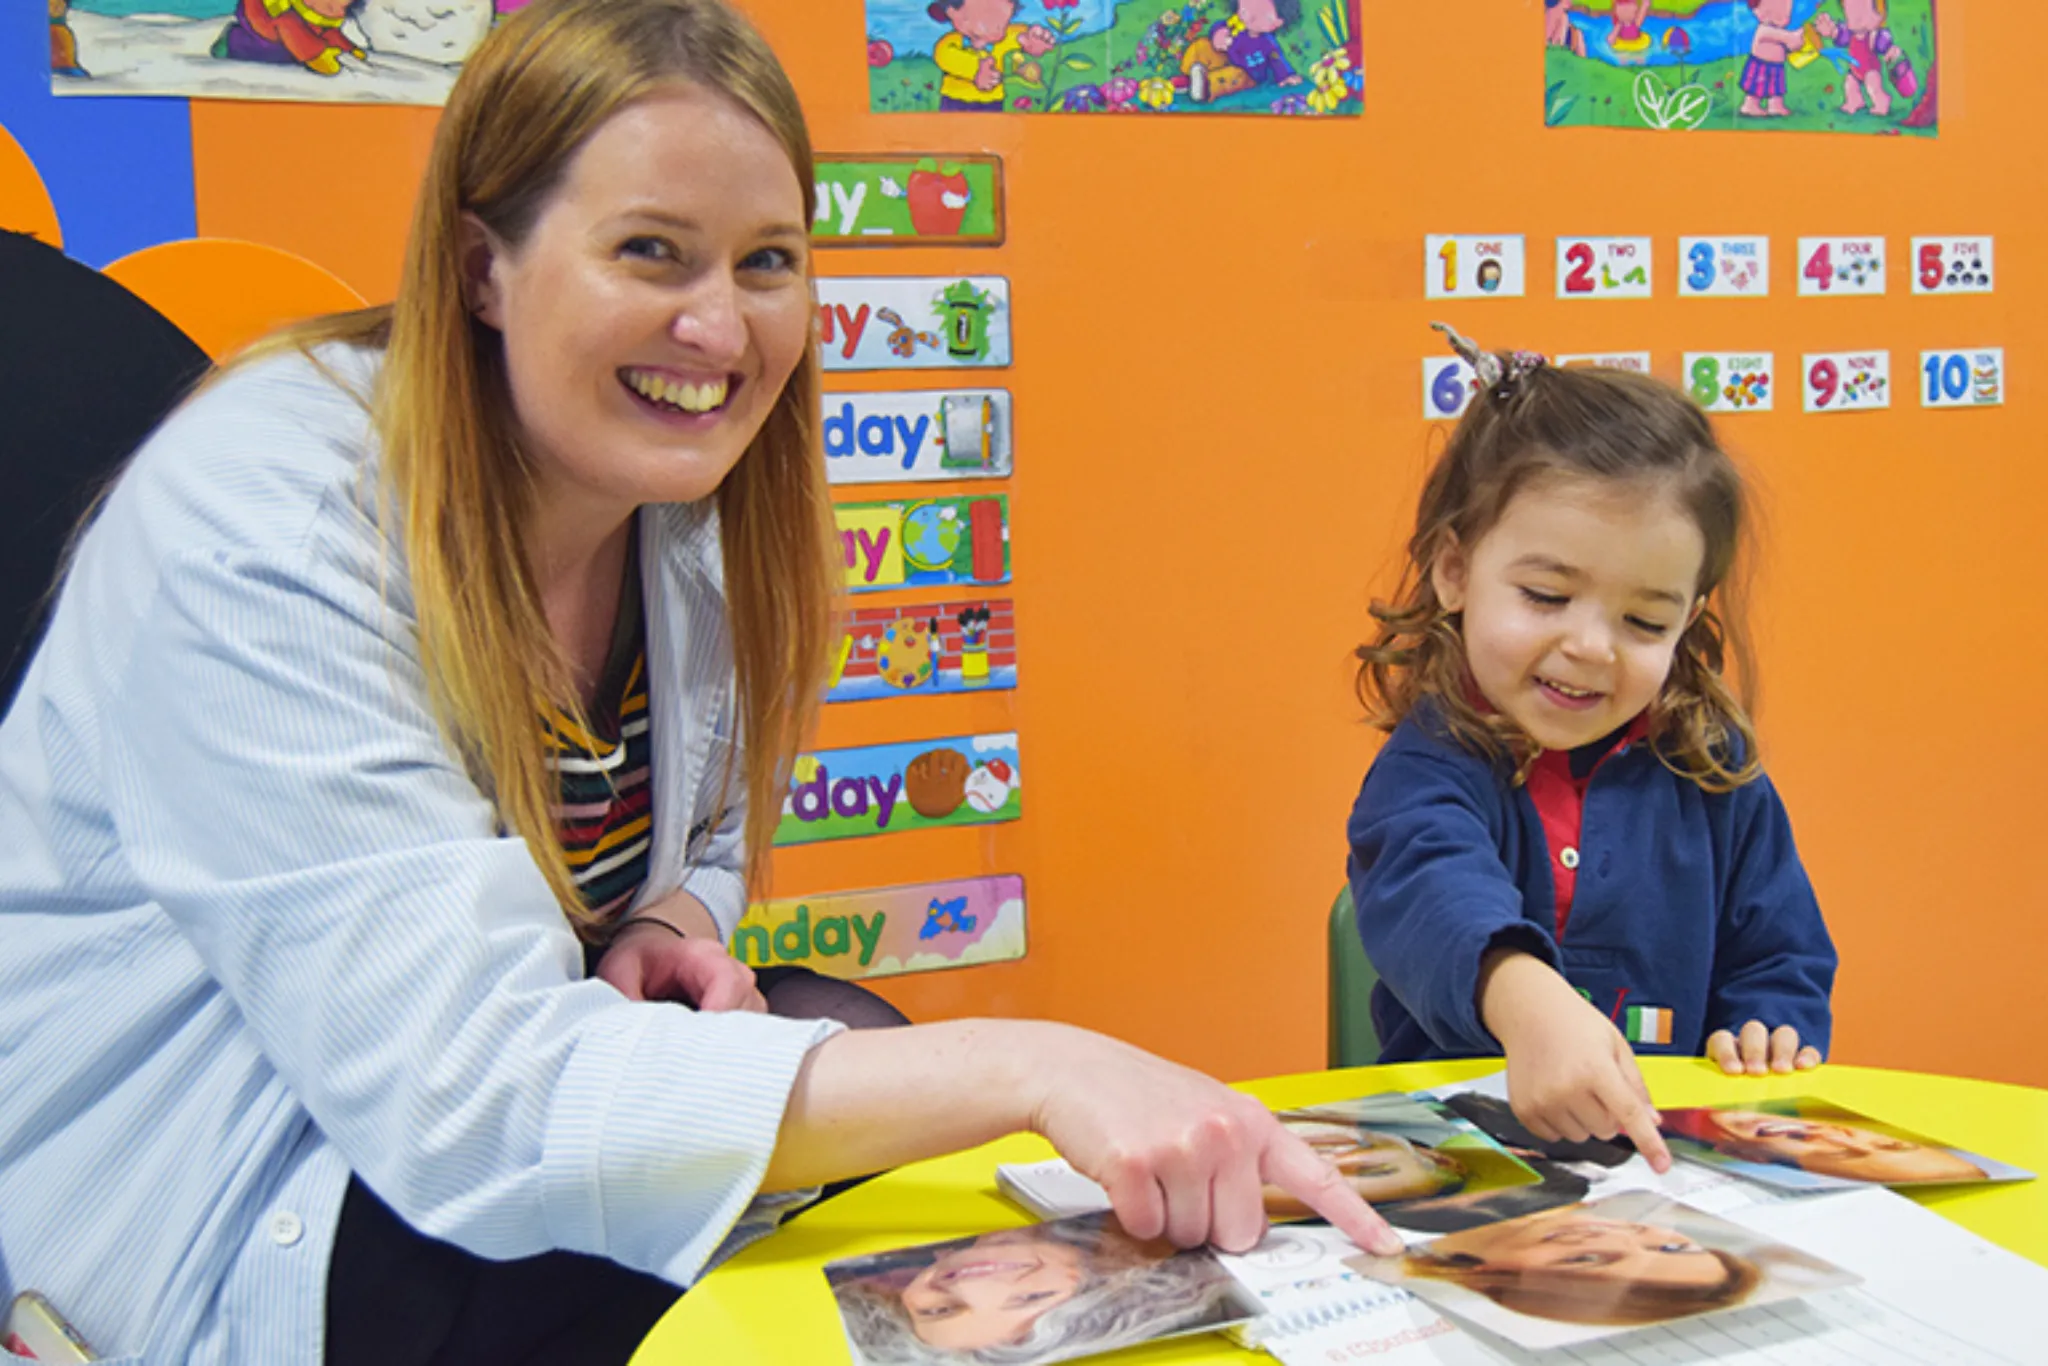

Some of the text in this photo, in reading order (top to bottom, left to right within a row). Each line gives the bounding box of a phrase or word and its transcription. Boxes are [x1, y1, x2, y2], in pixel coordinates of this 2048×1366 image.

[1438, 240, 1457, 291] 1
[1475, 242, 1503, 256] ONE
[1565, 242, 1596, 293] 2
[1608, 243, 1636, 257] TWO
[1687, 242, 1716, 291] 3
[1721, 242, 1756, 256] THREE
[1803, 243, 1833, 291] 4
[1842, 242, 1872, 255] FOUR
[1919, 243, 1944, 289] 5
[1952, 242, 1980, 255] FIVE
[1432, 363, 1465, 414] 6
[1691, 356, 1720, 406] 8
[1809, 358, 1839, 408] 9
[1925, 354, 1969, 402] 10
[732, 903, 886, 966] nday
